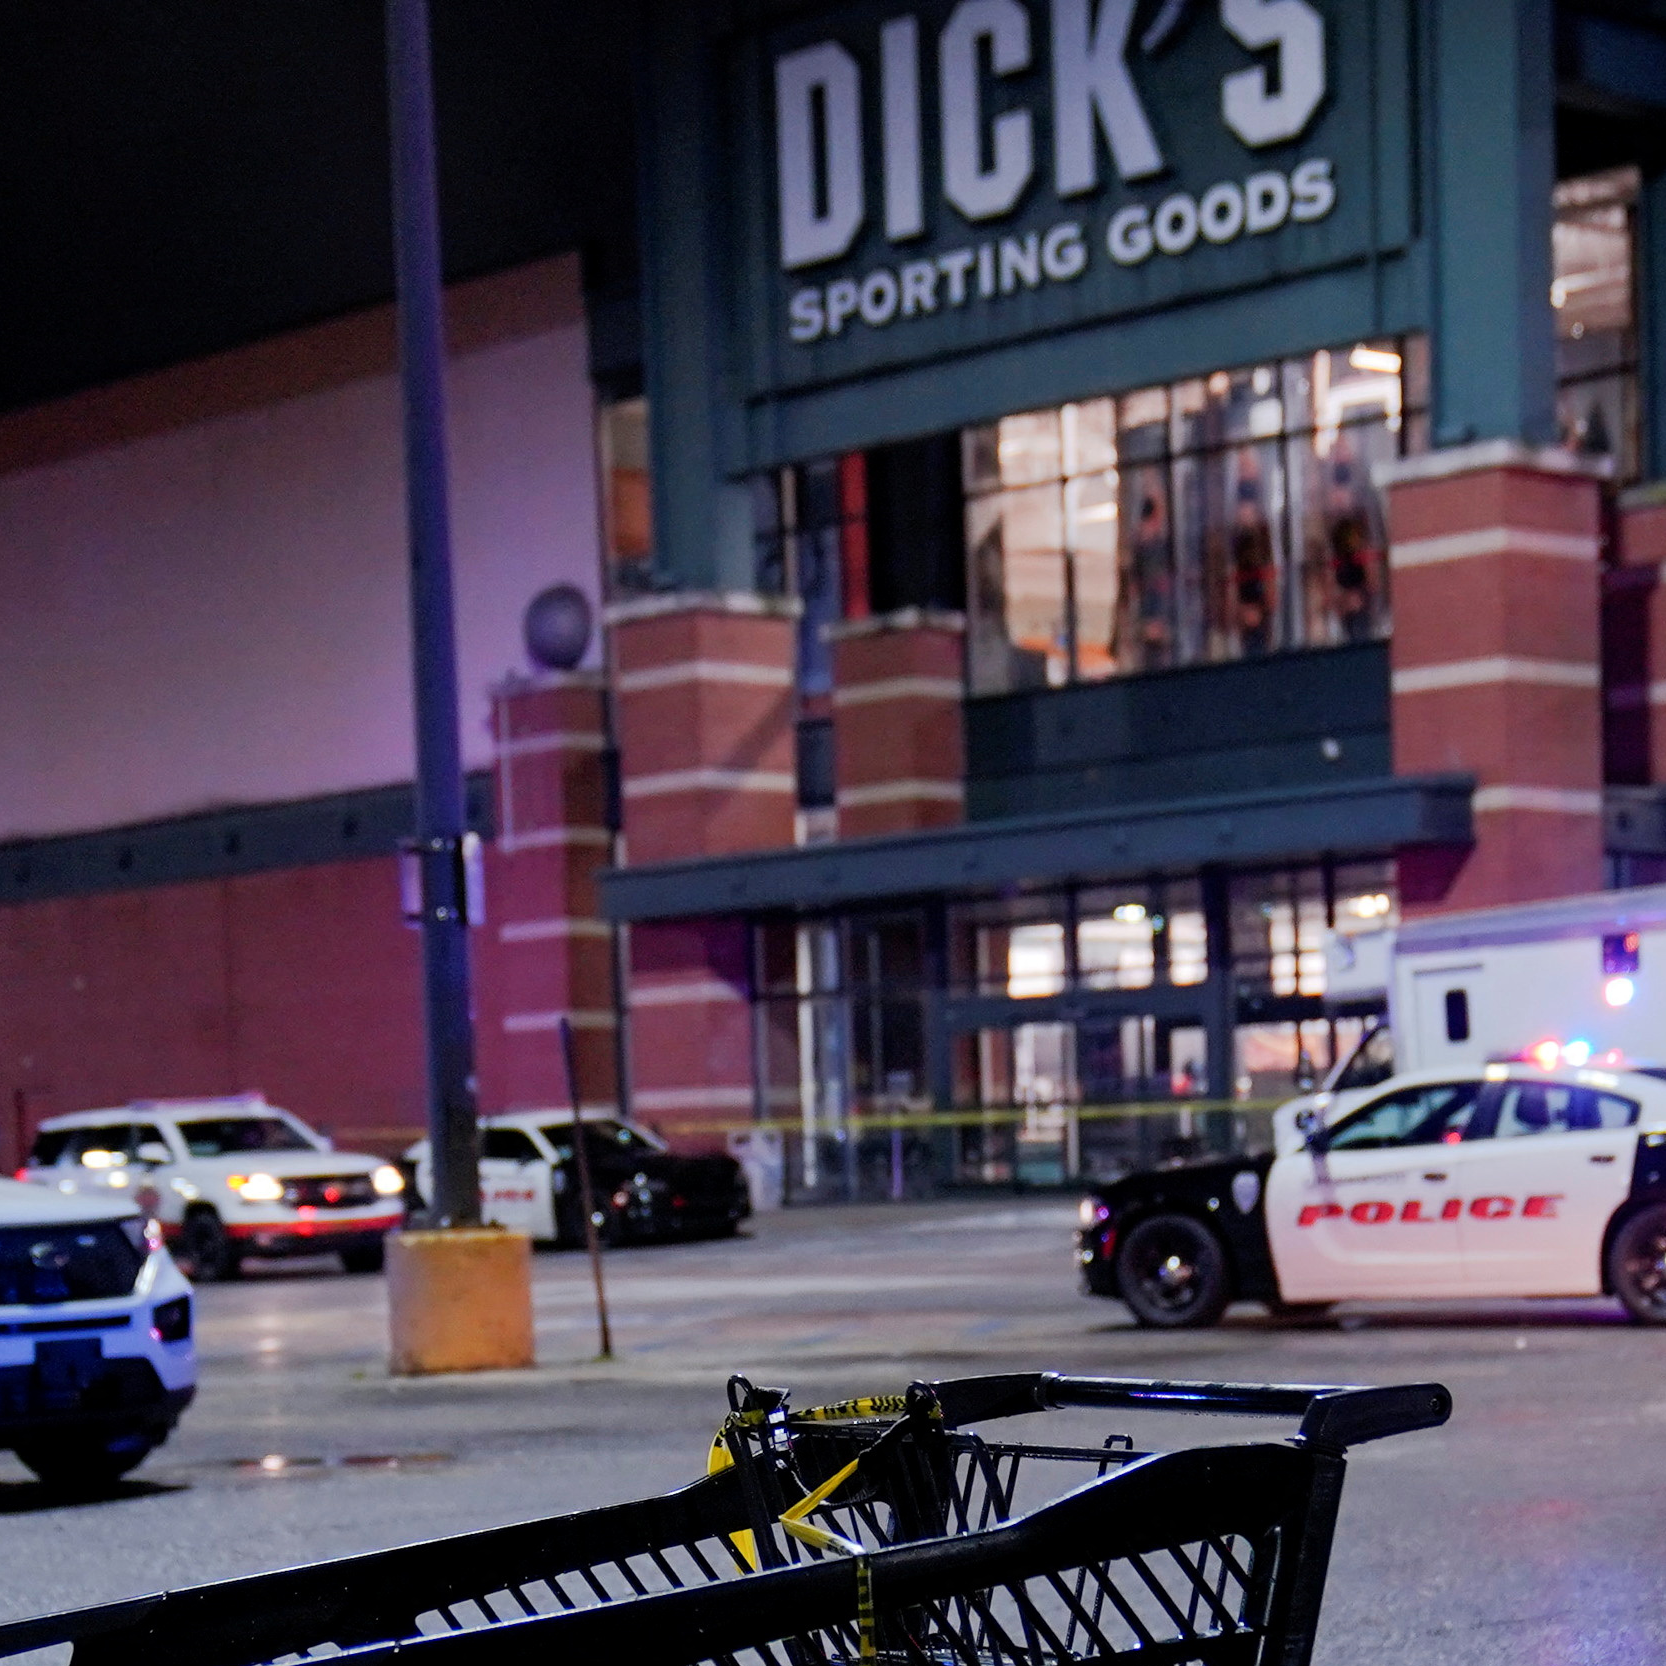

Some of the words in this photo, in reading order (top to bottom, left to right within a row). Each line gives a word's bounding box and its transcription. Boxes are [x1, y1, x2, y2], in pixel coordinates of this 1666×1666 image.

[776, 0, 1328, 270] DICK'S
[788, 225, 1086, 343] SPORTING
[1106, 158, 1336, 266] GOODS
[1297, 1194, 1565, 1227] POLICE
